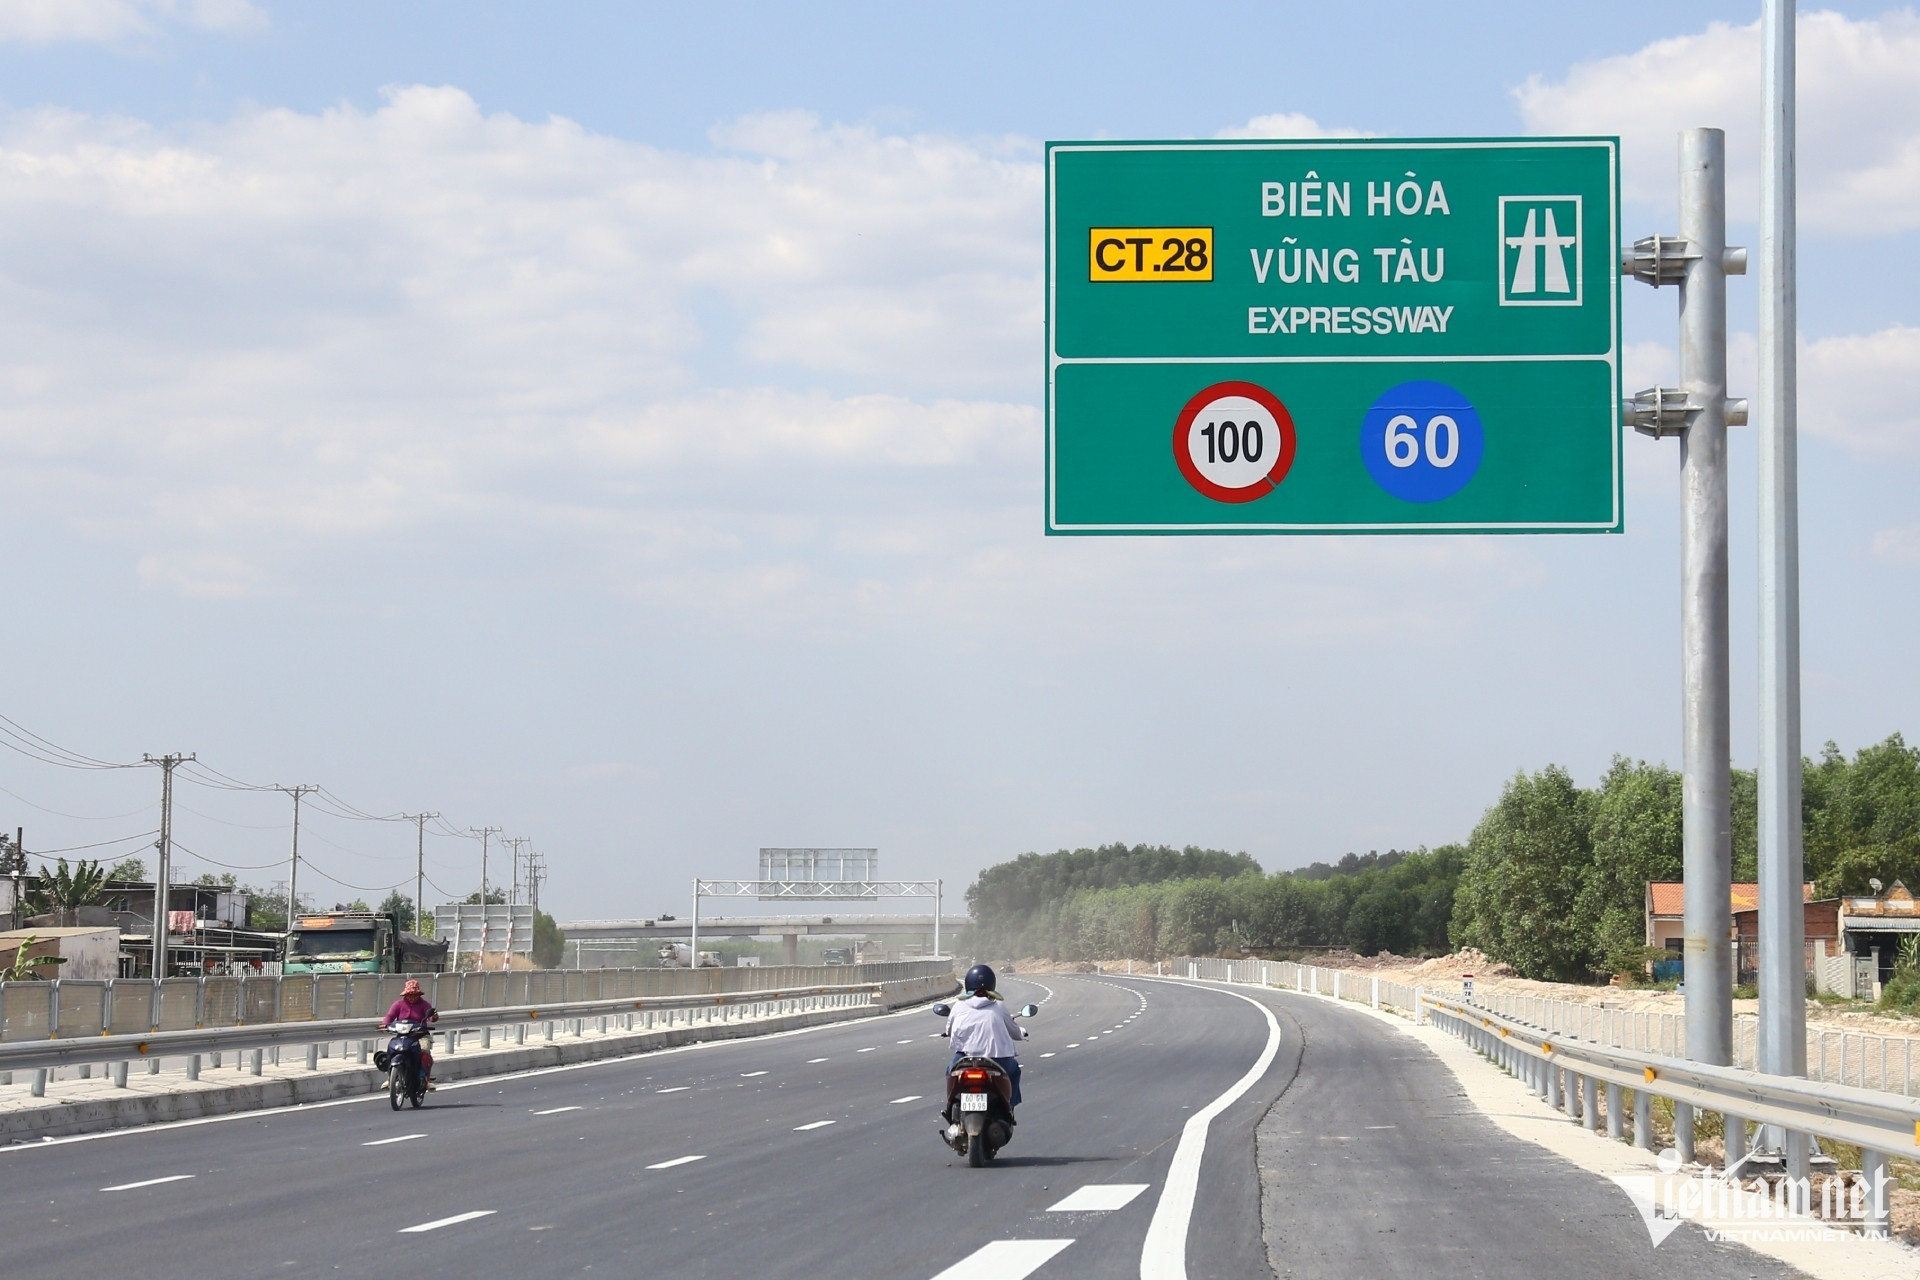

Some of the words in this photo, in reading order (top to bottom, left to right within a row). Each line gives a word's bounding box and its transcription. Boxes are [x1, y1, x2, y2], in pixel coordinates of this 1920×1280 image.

[1262, 171, 1351, 217] BIÊN
[1368, 171, 1451, 216] HÒA
[1095, 238, 1208, 272] CT.28
[1250, 237, 1360, 284] VŨNG
[1374, 238, 1445, 283] TÀU
[1248, 306, 1454, 334] EXPRESSWAY
[1201, 421, 1264, 463] 100
[1384, 415, 1459, 468] 60
